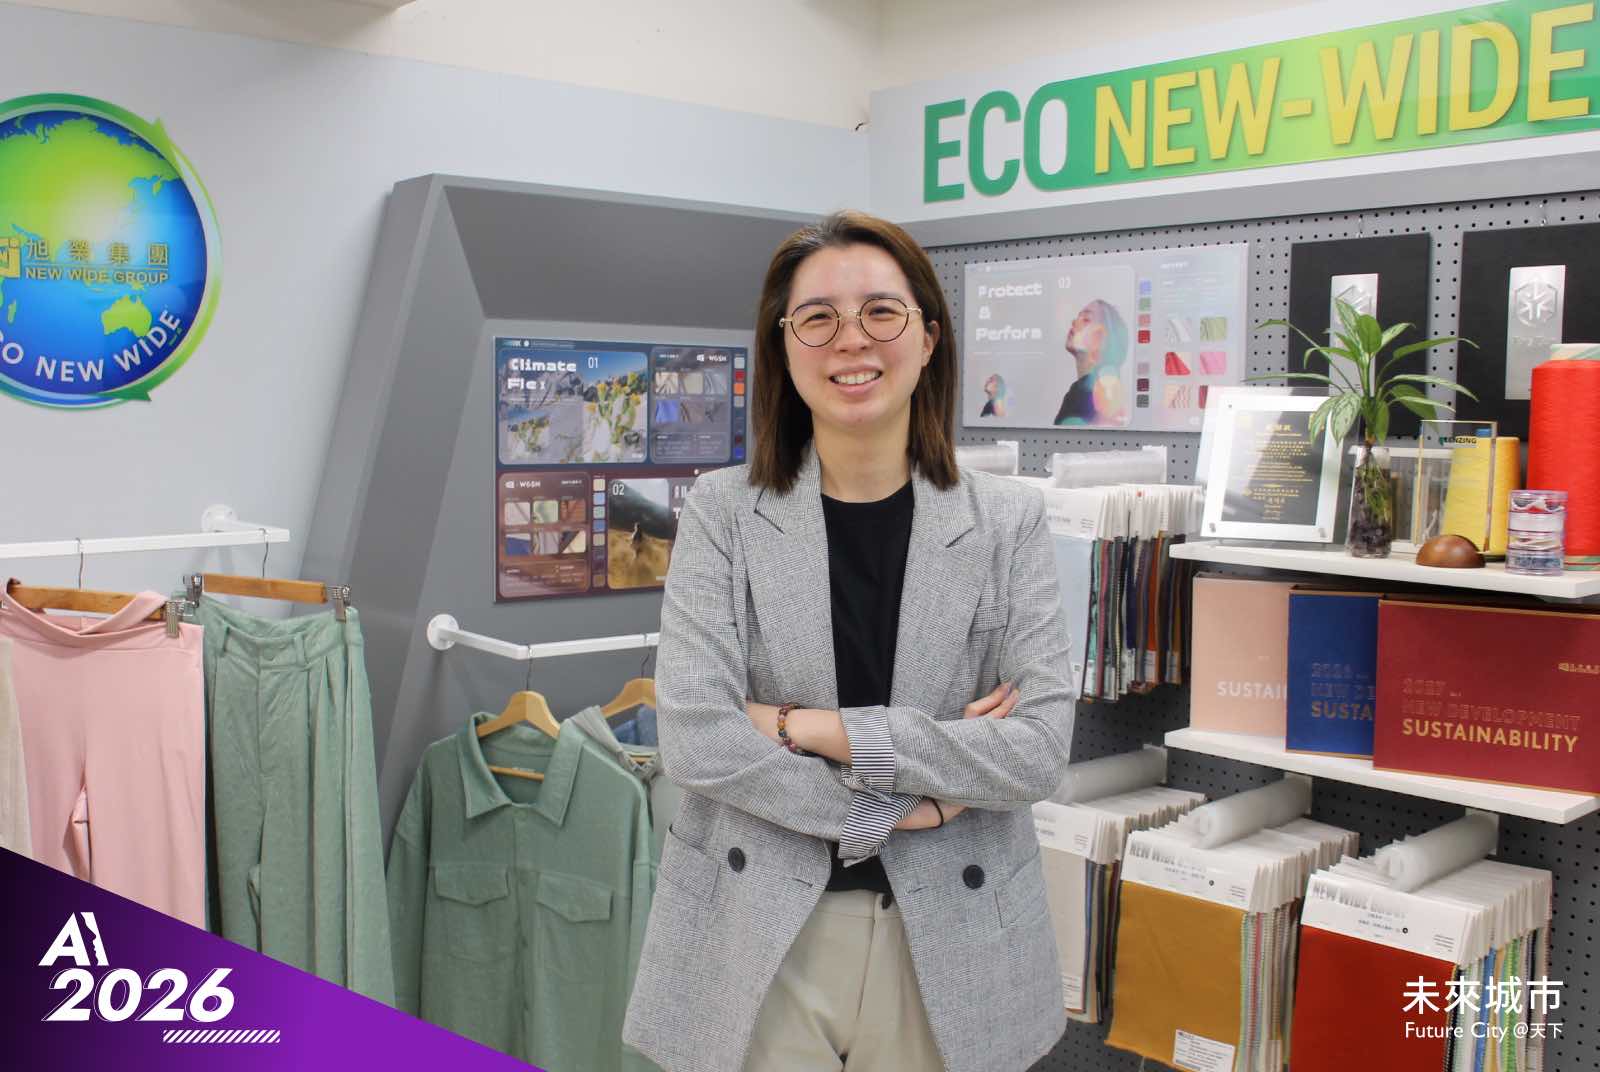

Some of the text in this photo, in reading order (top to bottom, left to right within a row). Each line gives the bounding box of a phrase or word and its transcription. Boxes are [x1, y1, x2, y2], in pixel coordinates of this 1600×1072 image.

[923, 3, 1595, 203] ECO NEW-WIDE
[26, 267, 169, 285] NEW WIDE GROUP
[977, 282, 1043, 298] Protect
[35, 354, 105, 383] NEW
[112, 309, 181, 373] WIDE
[509, 357, 578, 373] Climate
[587, 356, 600, 370] 01
[612, 483, 625, 496] 02
[1448, 703, 1582, 732] DEVELOPMENT
[1402, 718, 1579, 753] SUSTAINABILITY
